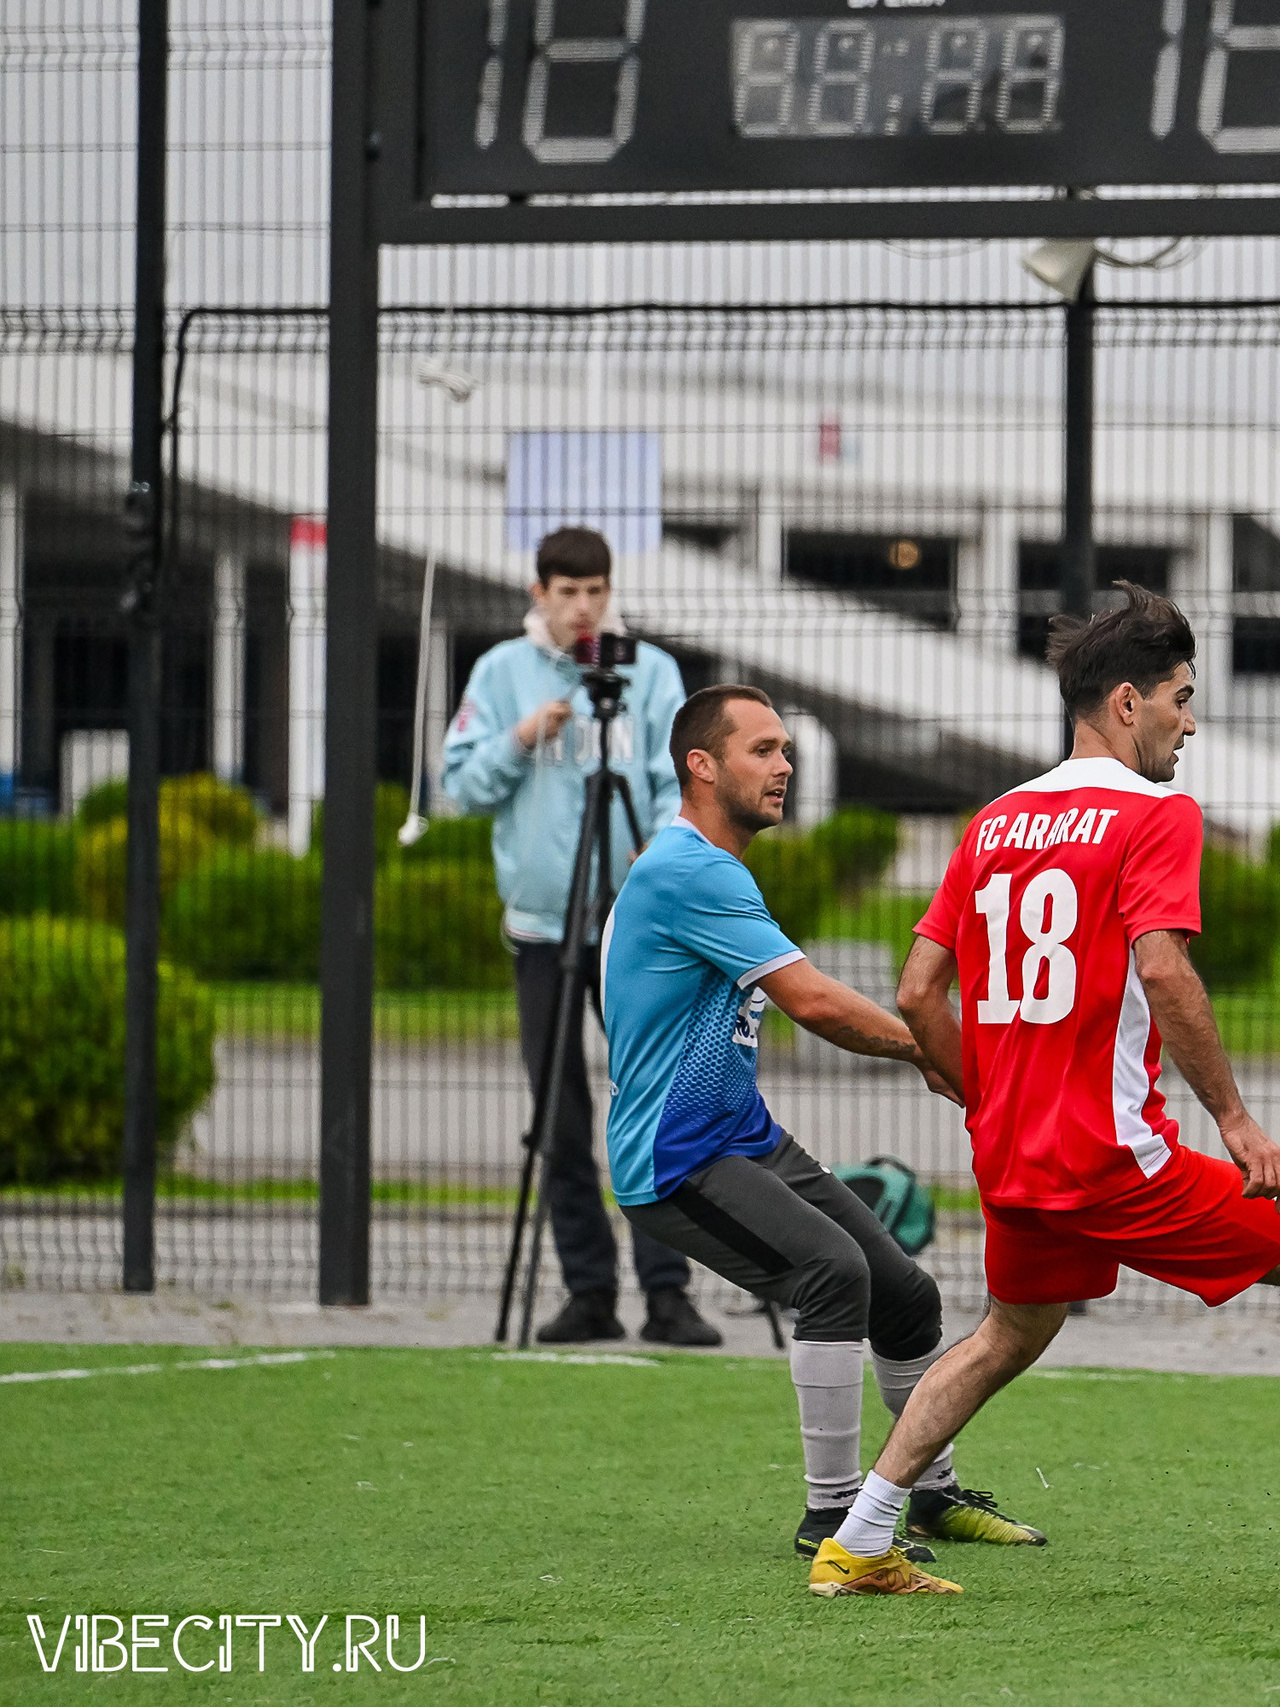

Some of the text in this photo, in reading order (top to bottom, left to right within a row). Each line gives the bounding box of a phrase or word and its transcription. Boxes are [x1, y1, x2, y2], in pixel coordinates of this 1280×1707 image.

[975, 807, 1119, 857] FC ARARAT
[974, 868, 1078, 1025] 18
